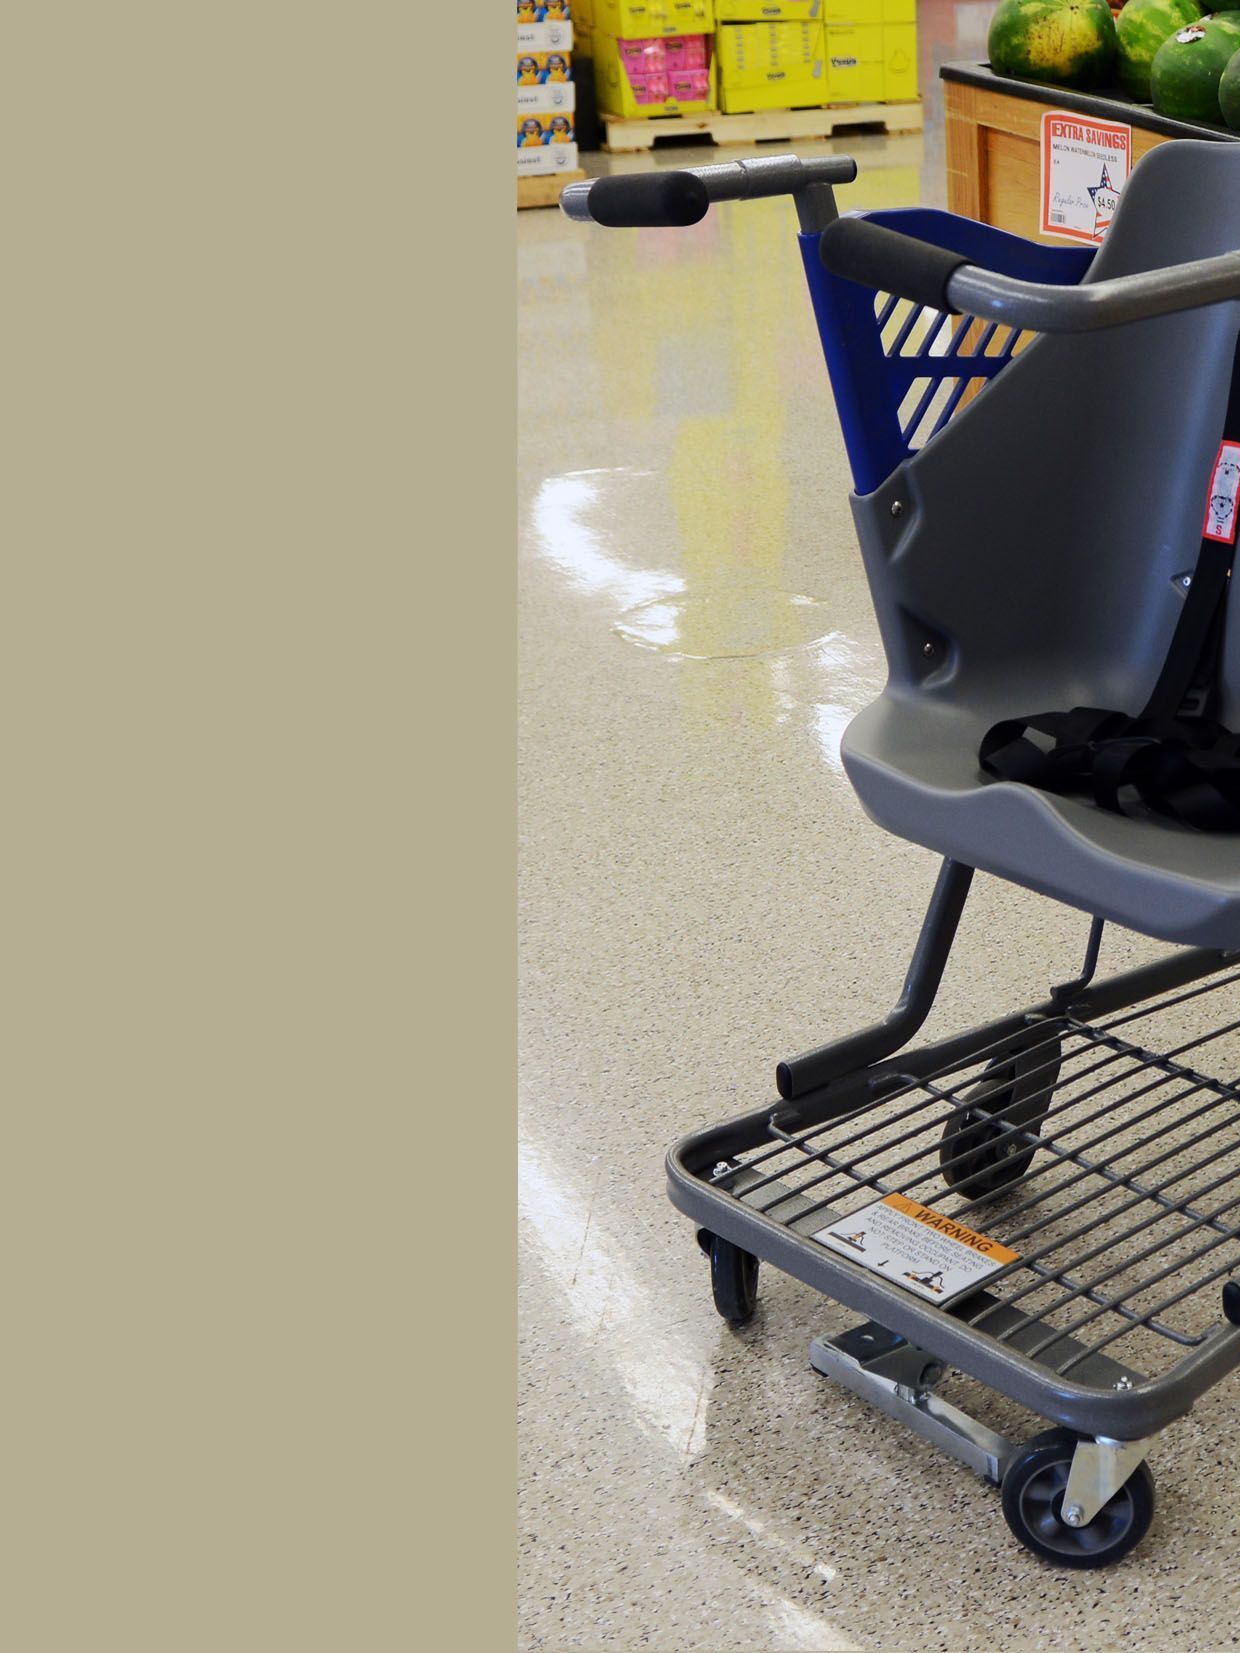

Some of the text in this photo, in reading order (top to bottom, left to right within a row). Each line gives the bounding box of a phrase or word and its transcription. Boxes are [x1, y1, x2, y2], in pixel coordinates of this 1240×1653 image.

[1052, 122, 1126, 150] EXTRA SAVINGS
[1097, 196, 1116, 211] $4.50
[915, 1209, 993, 1252] WARNING
